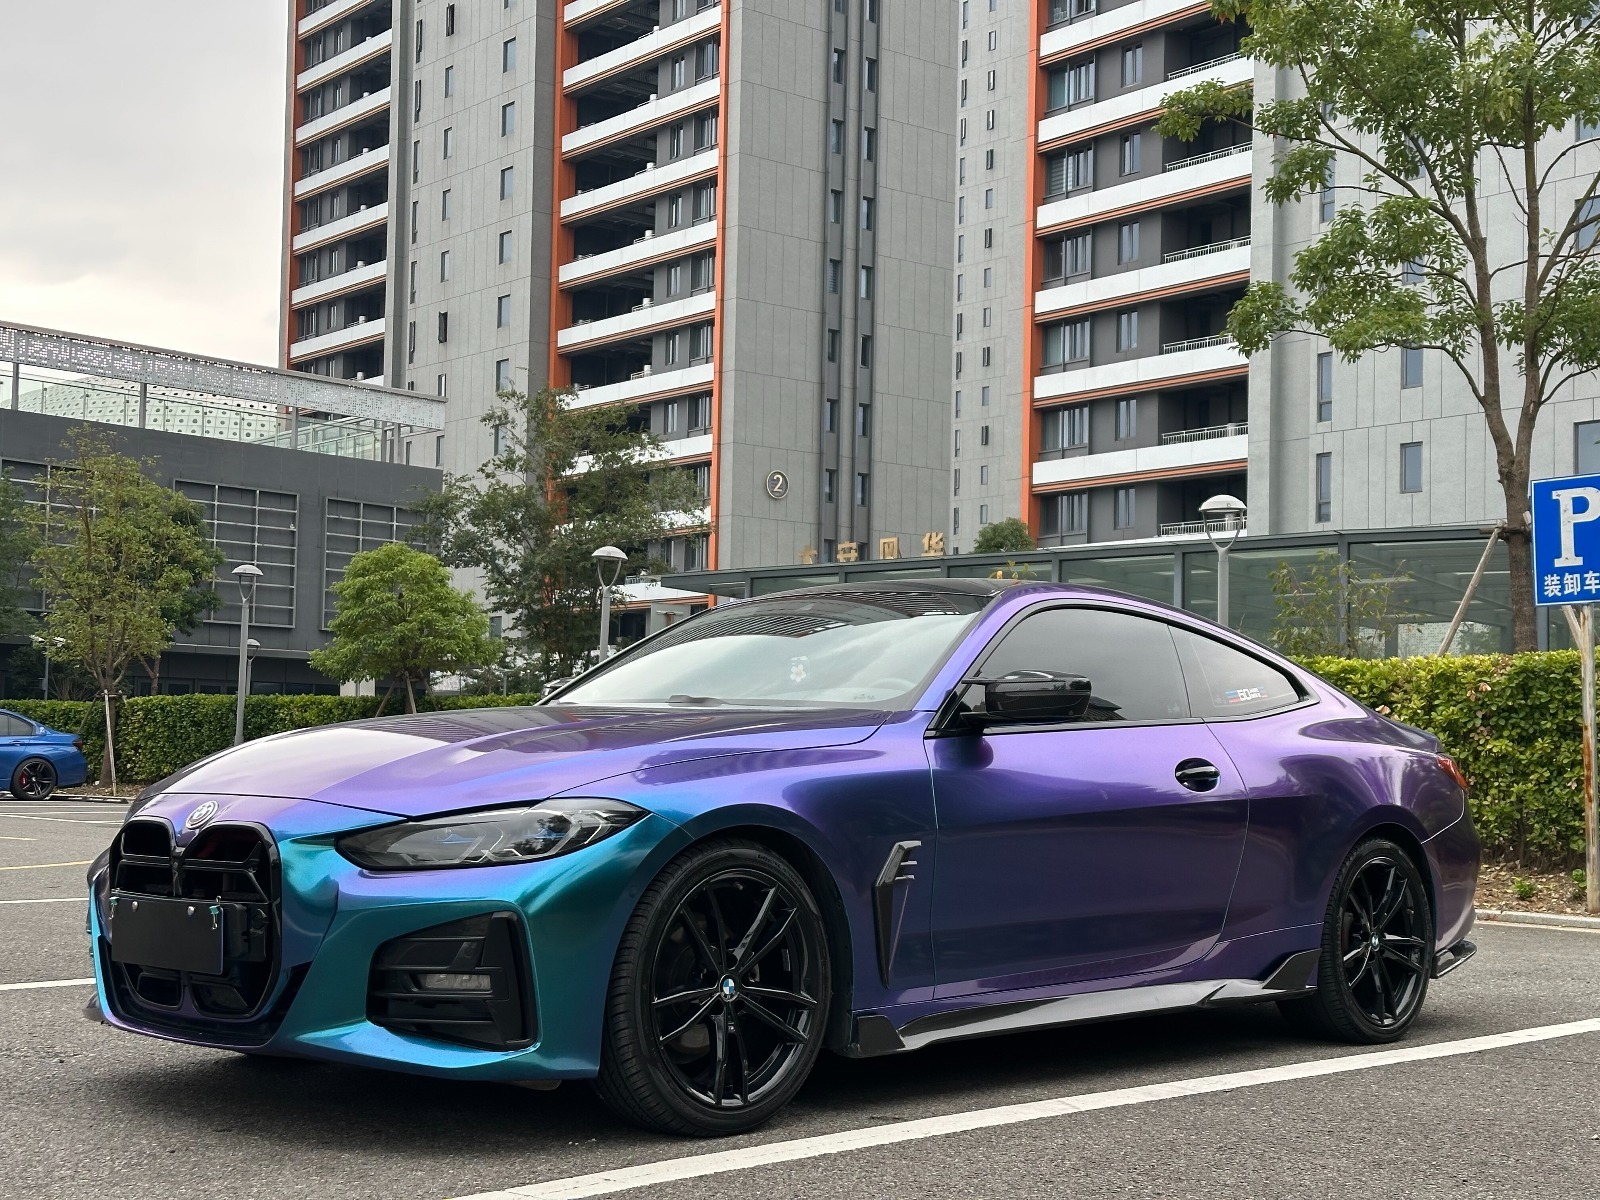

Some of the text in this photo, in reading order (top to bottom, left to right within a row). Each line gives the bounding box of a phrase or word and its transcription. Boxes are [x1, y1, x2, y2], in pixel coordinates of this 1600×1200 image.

[773, 474, 783, 492] 2
[1552, 486, 1600, 568] P
[1544, 570, 1600, 598] 装卸车
